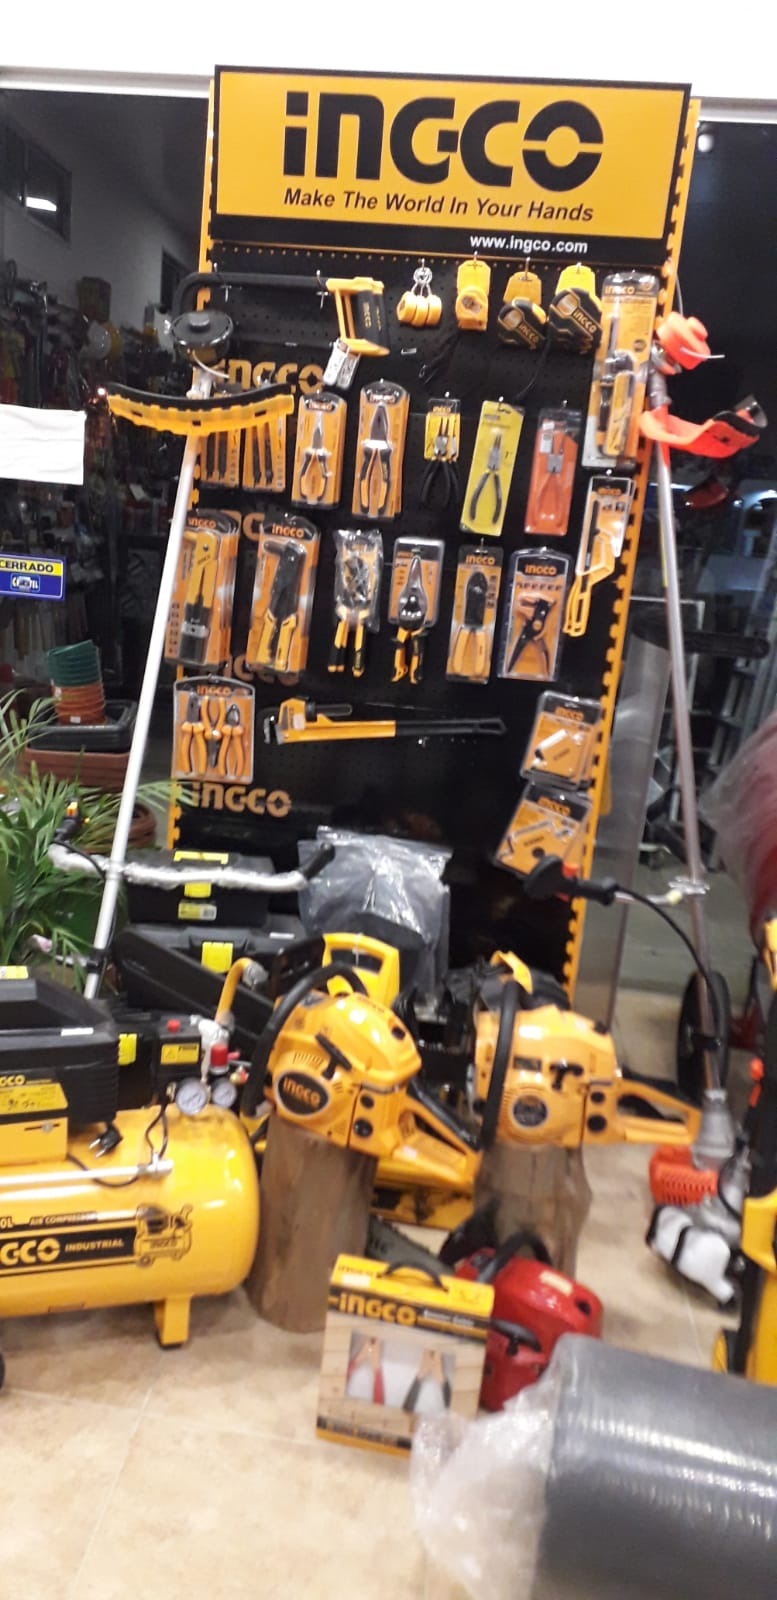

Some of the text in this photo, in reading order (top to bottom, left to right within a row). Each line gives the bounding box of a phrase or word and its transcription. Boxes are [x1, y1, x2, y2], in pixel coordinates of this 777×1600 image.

[283, 91, 604, 192] INGCO
[283, 187, 593, 222] Make The World In Your Hands
[469, 234, 588, 254] www.ingco.com
[65, 1238, 125, 1253] INDUSTRIAL
[338, 1292, 417, 1327] INGCO
